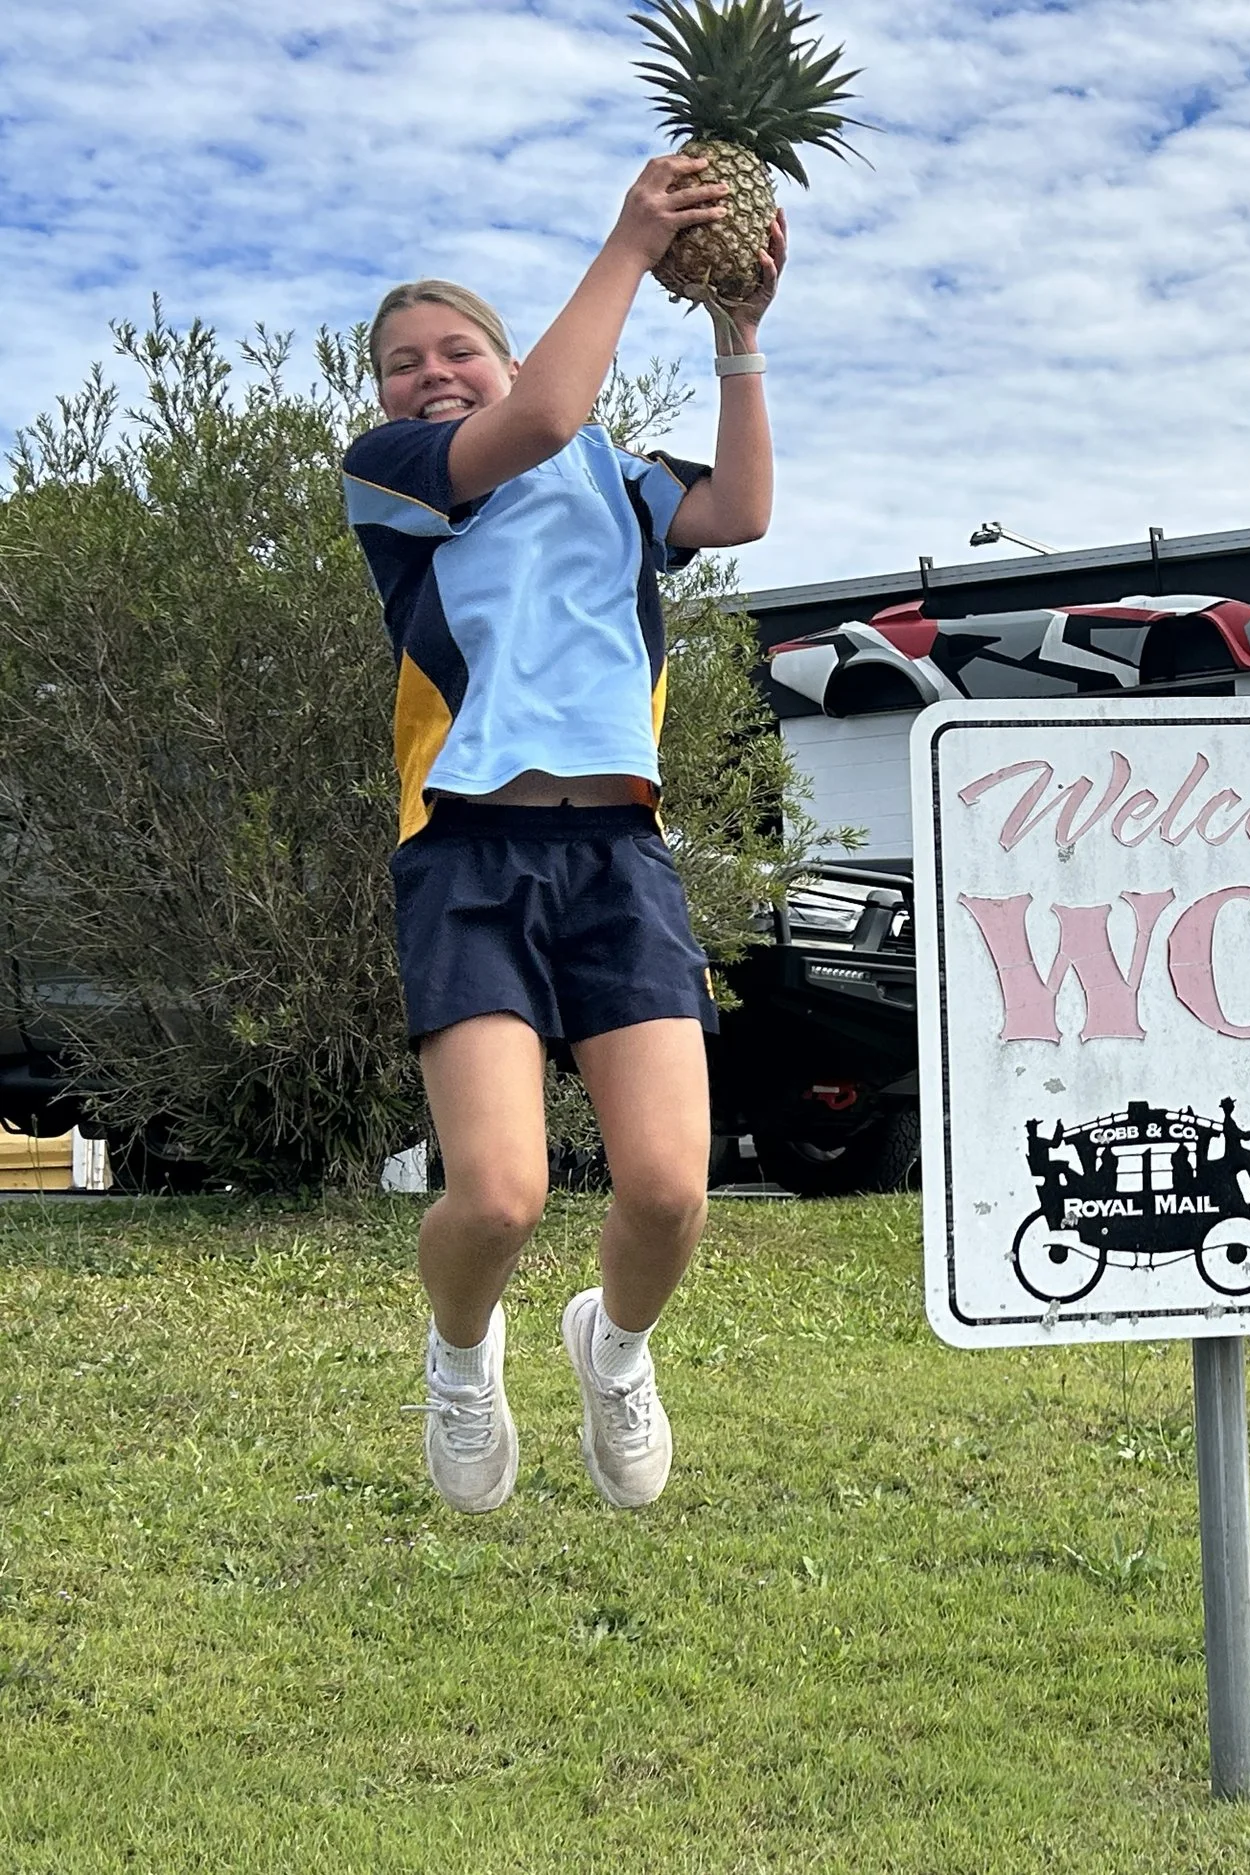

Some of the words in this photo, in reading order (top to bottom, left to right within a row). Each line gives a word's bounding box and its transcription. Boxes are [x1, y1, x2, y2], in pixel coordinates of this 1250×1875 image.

[1089, 1126, 1139, 1144] COBB
[1146, 1123, 1162, 1138] &
[1063, 1198, 1143, 1218] ROYAL
[1155, 1194, 1219, 1215] MAIL
